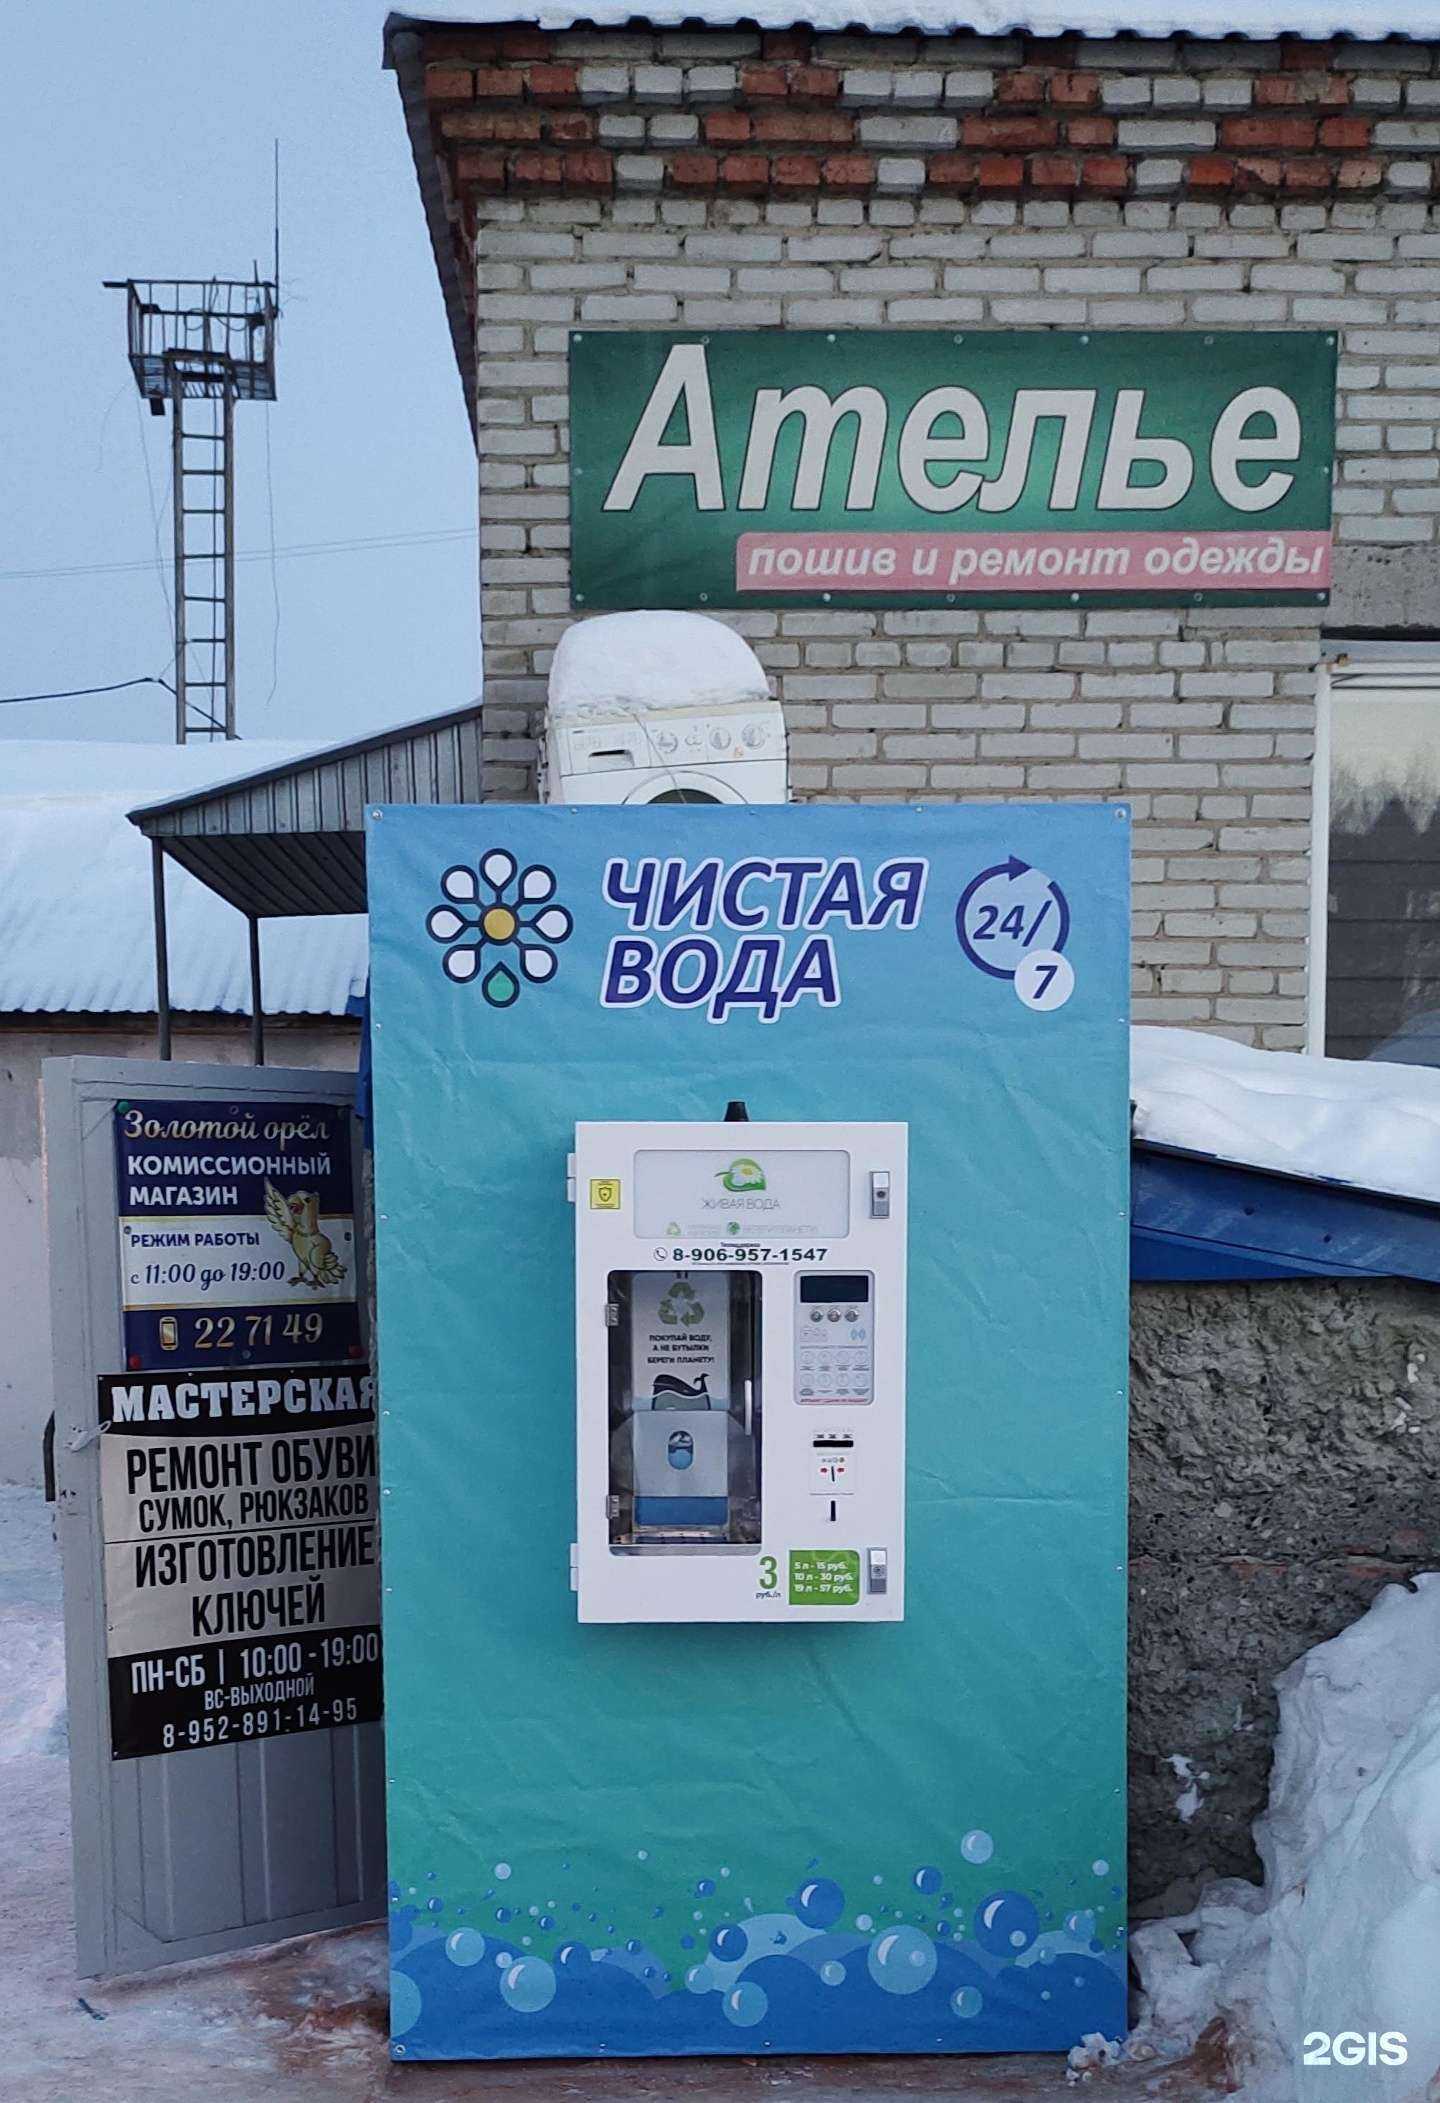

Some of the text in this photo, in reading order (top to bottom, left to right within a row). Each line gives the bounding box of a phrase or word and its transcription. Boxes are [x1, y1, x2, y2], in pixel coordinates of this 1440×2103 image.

[603, 343, 1302, 513] Ателье
[748, 537, 1323, 585] пошив и ремонт одежды
[604, 858, 928, 929] ЧИСТАЯ
[602, 936, 838, 1021] ВОДА
[124, 1110, 330, 1150] Золотой орёл
[127, 1152, 331, 1176] КОМИССИОННЫЙ
[130, 1186, 238, 1206] МАГАЗИН
[131, 1232, 259, 1248] РЕЖИМ РАБОТЫ
[672, 1248, 828, 1261] 8-906-957-1547
[131, 1261, 285, 1290] с 11:00 до 19:00
[194, 1312, 323, 1348] 22 71 49
[111, 1376, 376, 1422] МАСТЕРСКАЯ
[127, 1434, 376, 1494] РЕМОНТ ОБУВИ
[139, 1483, 368, 1532] СУМОК, РЮКЗАКОВ
[135, 1525, 375, 1588] ИЗГОТОВЛЕНИЕ
[760, 1556, 777, 1589] 3
[192, 1575, 326, 1636] КЛЮЧЕЙ
[131, 1653, 205, 1694] ПН-СБ
[240, 1642, 300, 1678] 10:00
[205, 1673, 314, 1710] ВС-ВЫХОДНОЙ
[163, 1698, 357, 1748] 8-952-891-14-95
